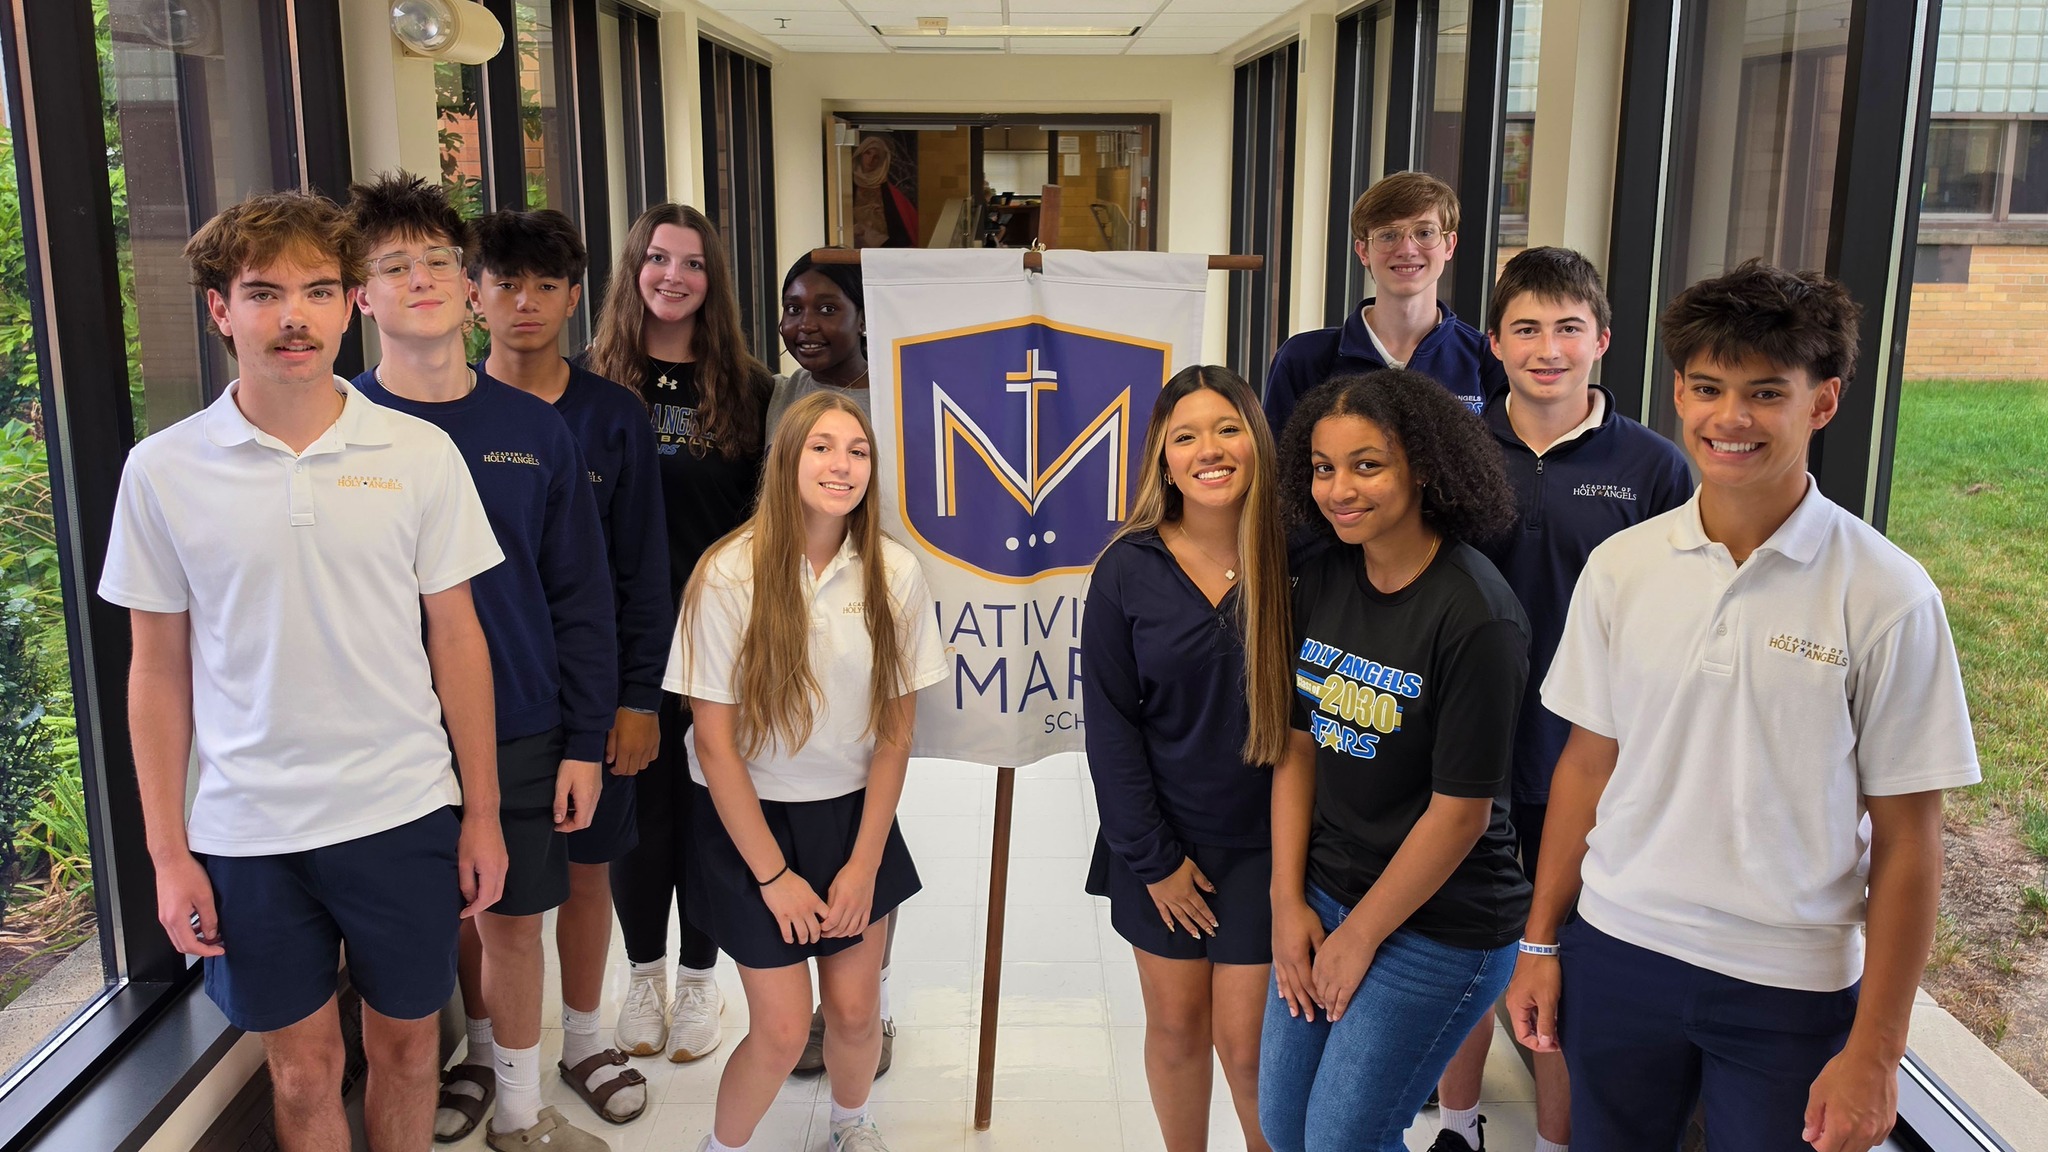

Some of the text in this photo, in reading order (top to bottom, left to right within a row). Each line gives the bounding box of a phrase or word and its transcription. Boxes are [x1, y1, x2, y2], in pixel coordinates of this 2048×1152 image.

[1455, 394, 1482, 402] NGELS
[483, 454, 540, 466] HOLY ANGELS
[337, 479, 404, 491] HOLY ANGELS
[1573, 487, 1637, 501] HOLY ANGELS
[1580, 483, 1618, 491] ACADEMY
[935, 595, 1086, 647] ATIVI
[1769, 637, 1849, 667] HOLY ANGELS
[1779, 634, 1844, 656] ACADEMY OF
[1300, 637, 1423, 698] HOLY ANGELS
[1320, 673, 1398, 734] 2030
